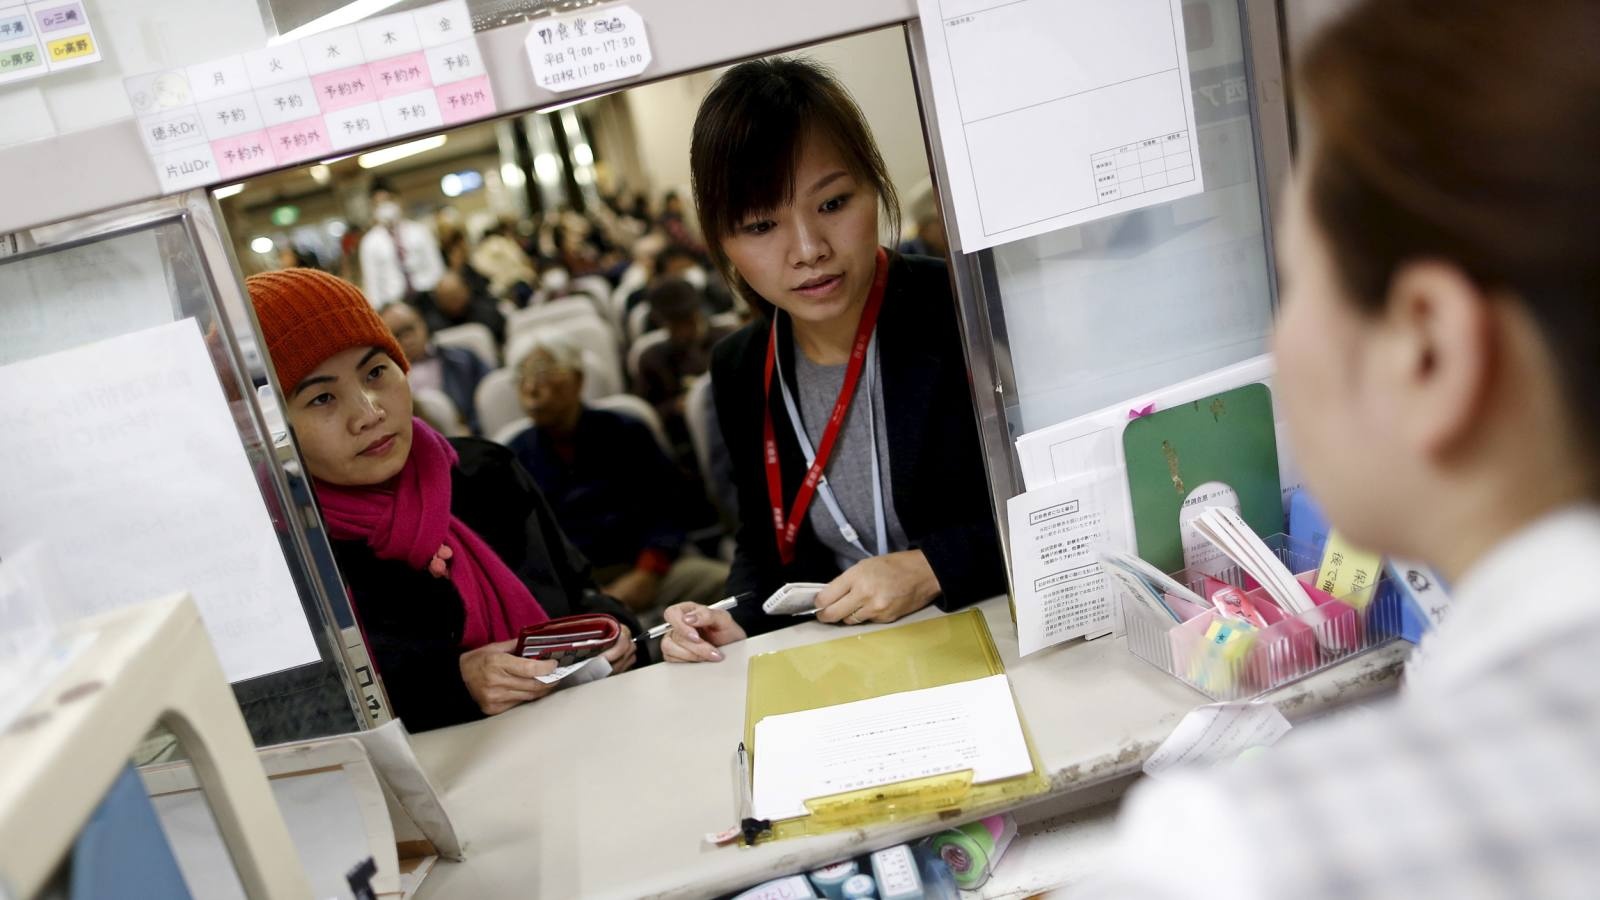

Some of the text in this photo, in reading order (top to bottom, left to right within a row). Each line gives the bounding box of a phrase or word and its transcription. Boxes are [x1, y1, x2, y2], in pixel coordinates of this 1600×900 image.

[214, 17, 452, 86] 月 火 水 木 金
[544, 69, 575, 85] 土日祝
[545, 53, 563, 67] 平日
[217, 109, 246, 125] 予約
[274, 95, 303, 111] 予約
[325, 79, 365, 99] 予約外
[381, 67, 422, 86] 予約外
[444, 54, 470, 72] 予約
[167, 89, 485, 179] 片山Dr 予約外 予約外 予約 予約 予約外
